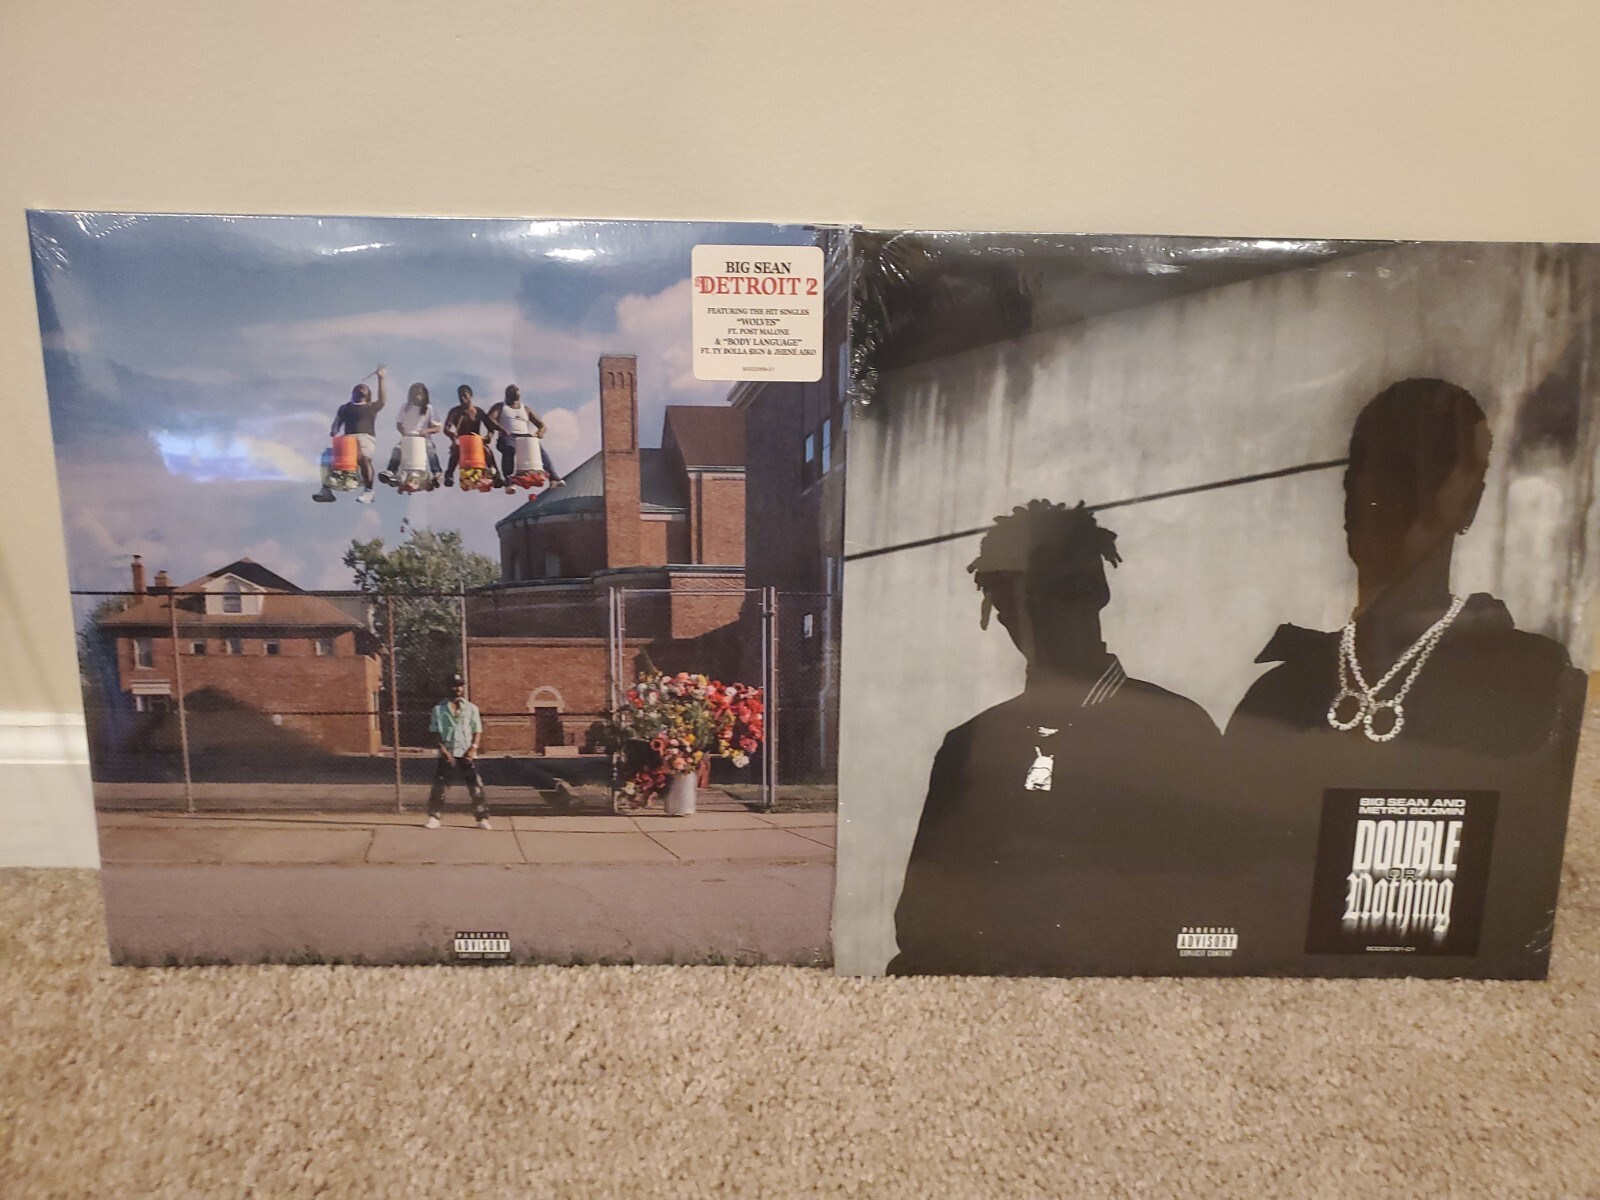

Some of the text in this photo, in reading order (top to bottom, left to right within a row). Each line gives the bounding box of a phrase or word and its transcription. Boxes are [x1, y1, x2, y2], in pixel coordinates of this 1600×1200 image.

[726, 261, 791, 274] BIG SEAN
[694, 276, 818, 296] DETROIT 2
[707, 307, 748, 315] FEATURING
[797, 348, 817, 356] AIKO
[1360, 797, 1466, 807] BIG SEAN AND
[1358, 806, 1465, 815] METRO BOOMIN
[1352, 819, 1463, 873] DOUBLE
[1387, 867, 1417, 881] OR
[1342, 872, 1454, 934] Nothing
[1181, 926, 1235, 934] PARENTAL
[457, 940, 507, 951] ADVISORY
[1180, 935, 1234, 948] ADVISORY
